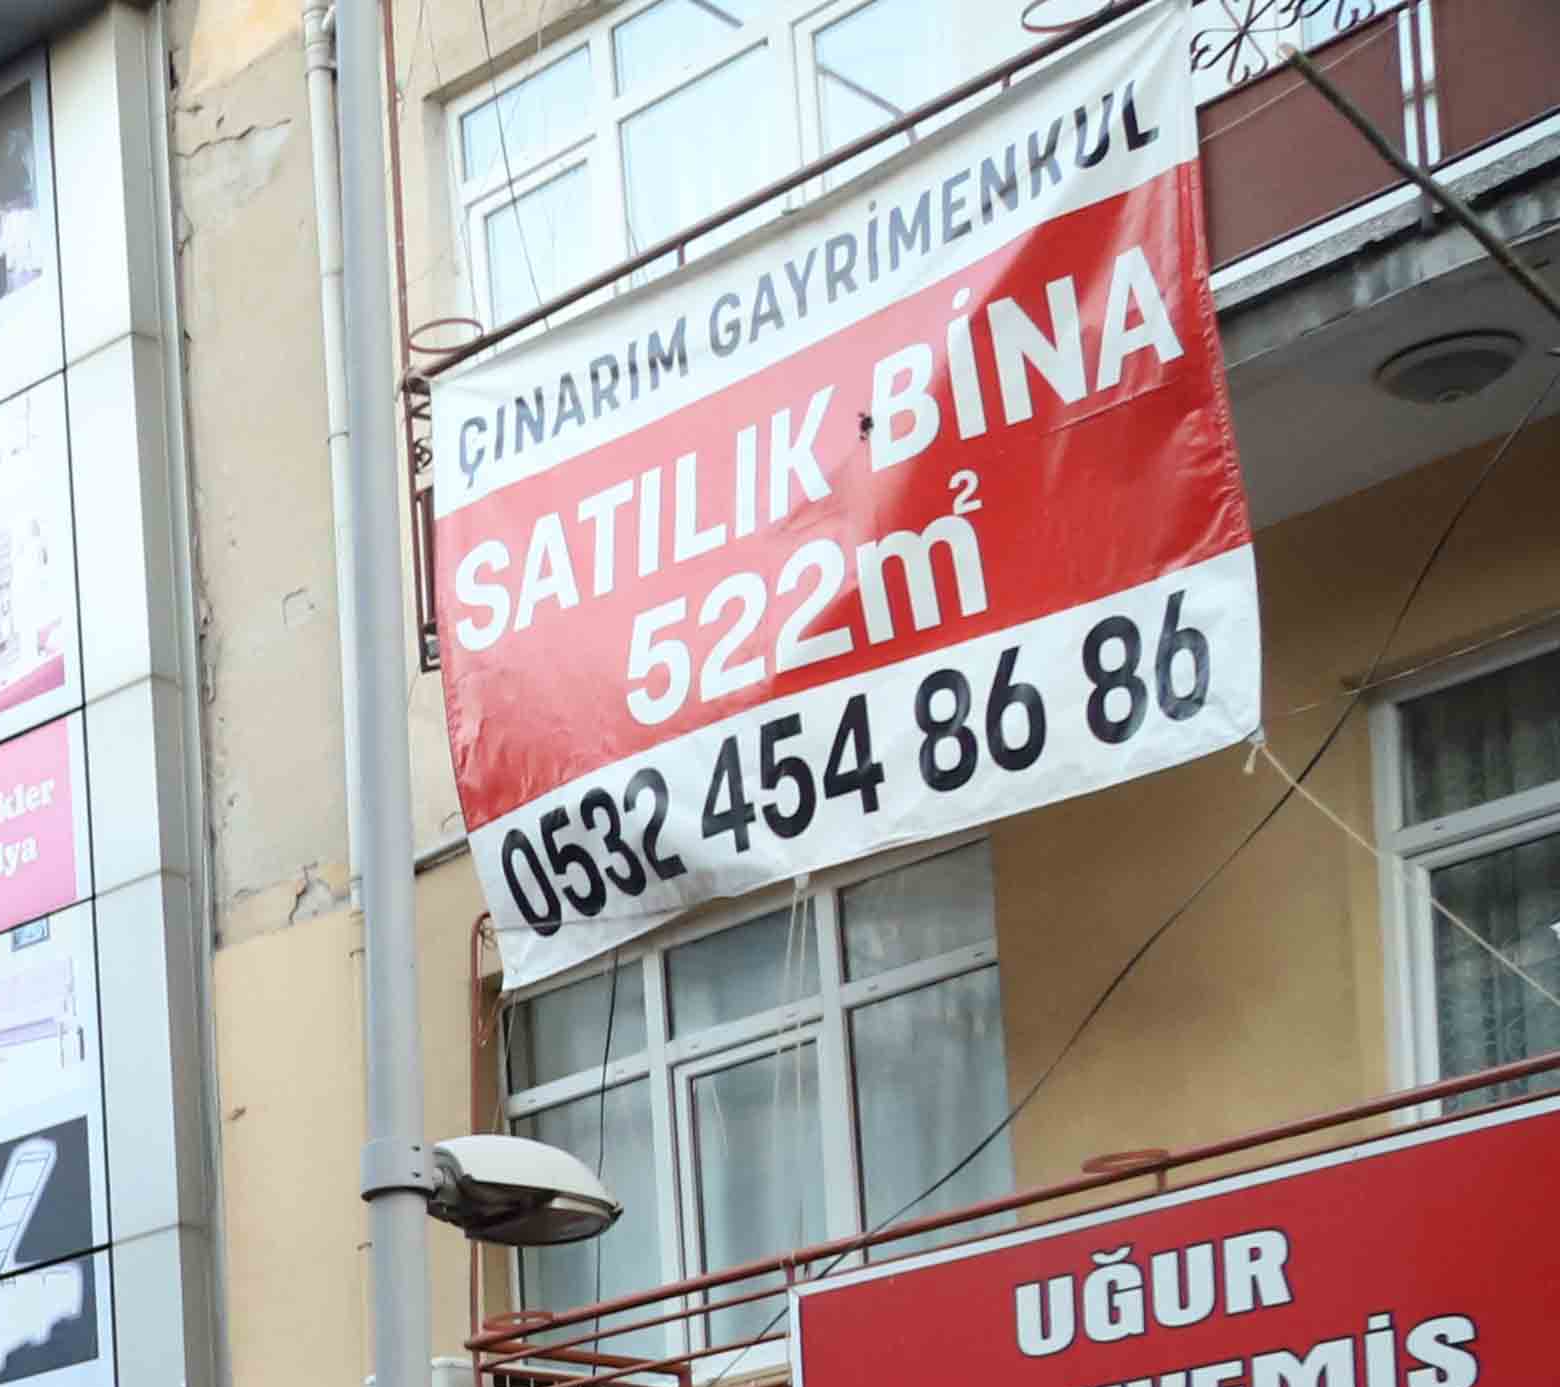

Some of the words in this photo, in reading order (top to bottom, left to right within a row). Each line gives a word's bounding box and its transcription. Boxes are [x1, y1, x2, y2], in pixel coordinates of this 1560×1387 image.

[453, 383, 837, 653] SATILIK
[870, 246, 1186, 473] BİNA
[457, 316, 691, 481] ÇINARIM
[708, 78, 1162, 359] GAYRİMENKUL
[499, 766, 687, 938] 0532
[700, 694, 885, 854] 454
[914, 646, 1047, 794] 86
[1082, 589, 1212, 745] 86
[1015, 1227, 1292, 1358] UĞUR
